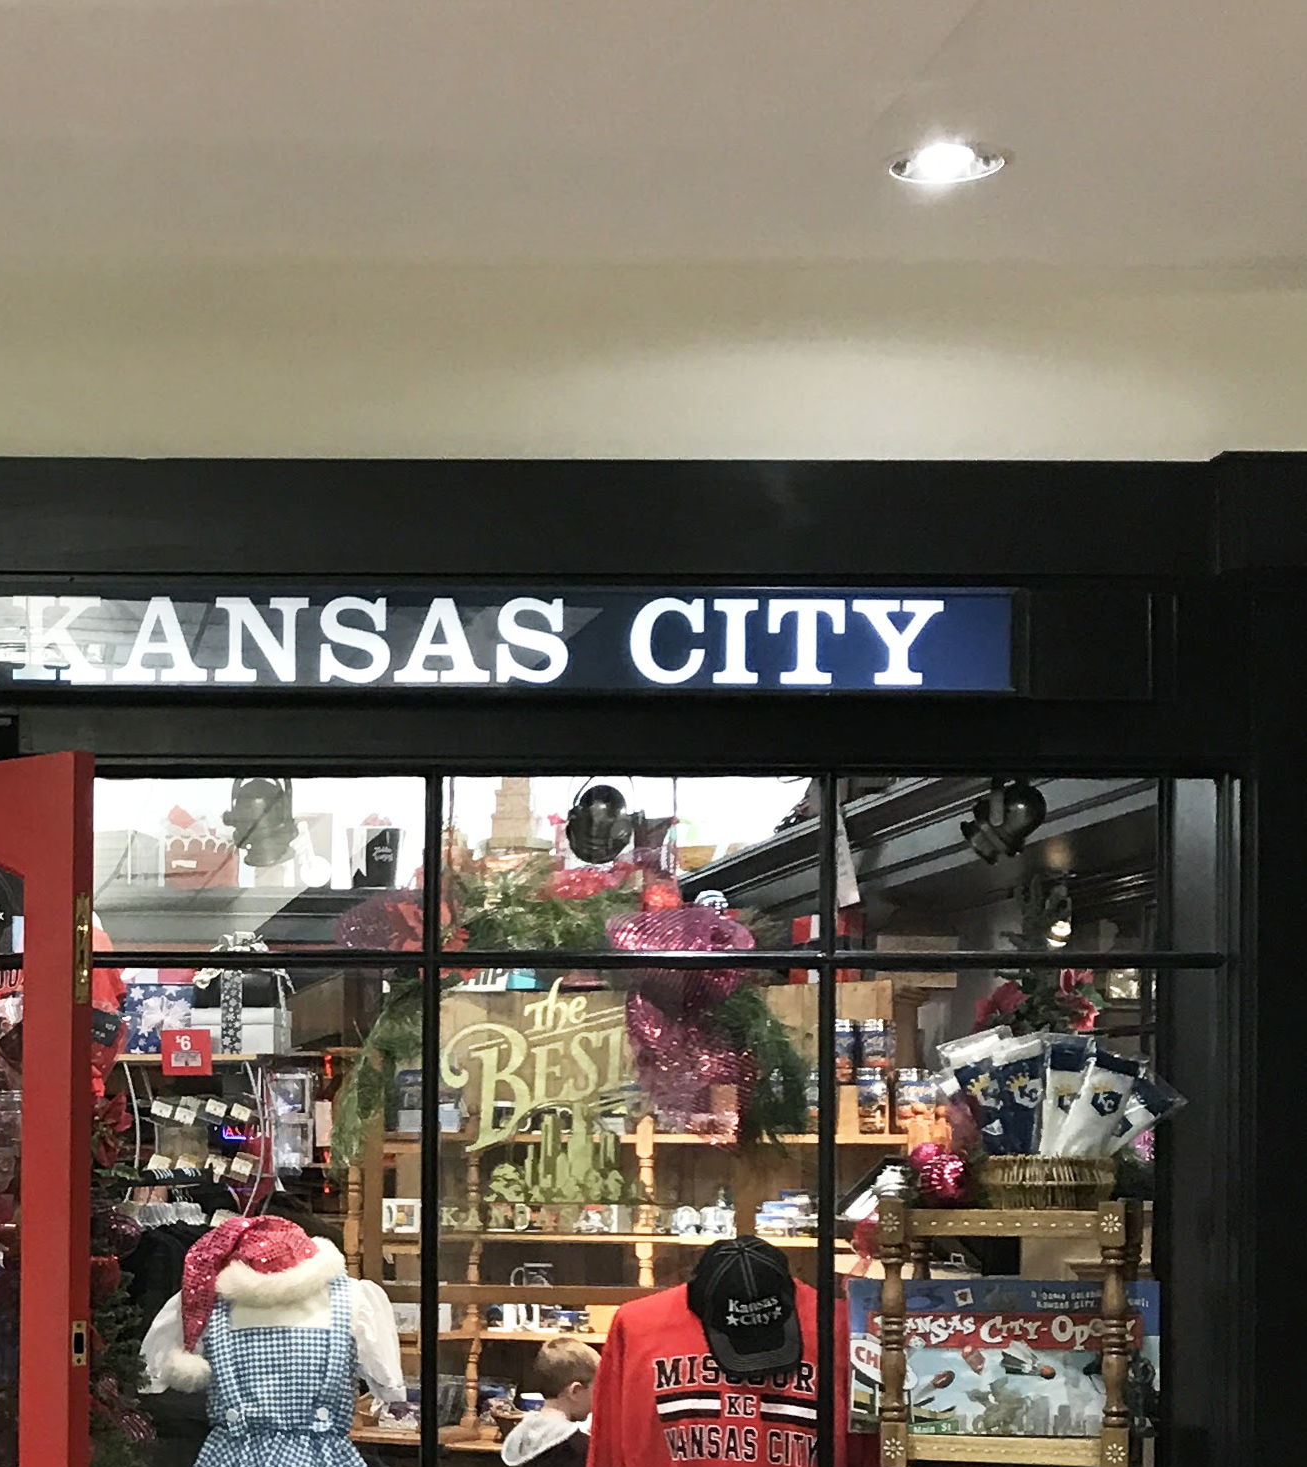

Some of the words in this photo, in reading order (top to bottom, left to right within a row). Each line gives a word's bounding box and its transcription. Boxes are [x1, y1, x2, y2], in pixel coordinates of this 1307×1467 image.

[13, 597, 569, 687] KANSAS
[629, 598, 944, 686] CITY
[523, 977, 587, 1033] the
[175, 1035, 192, 1051] $6
[440, 1022, 624, 1152] BEST
[728, 1296, 779, 1313] Kansas
[740, 1313, 771, 1325] City
[725, 1393, 757, 1418] KC
